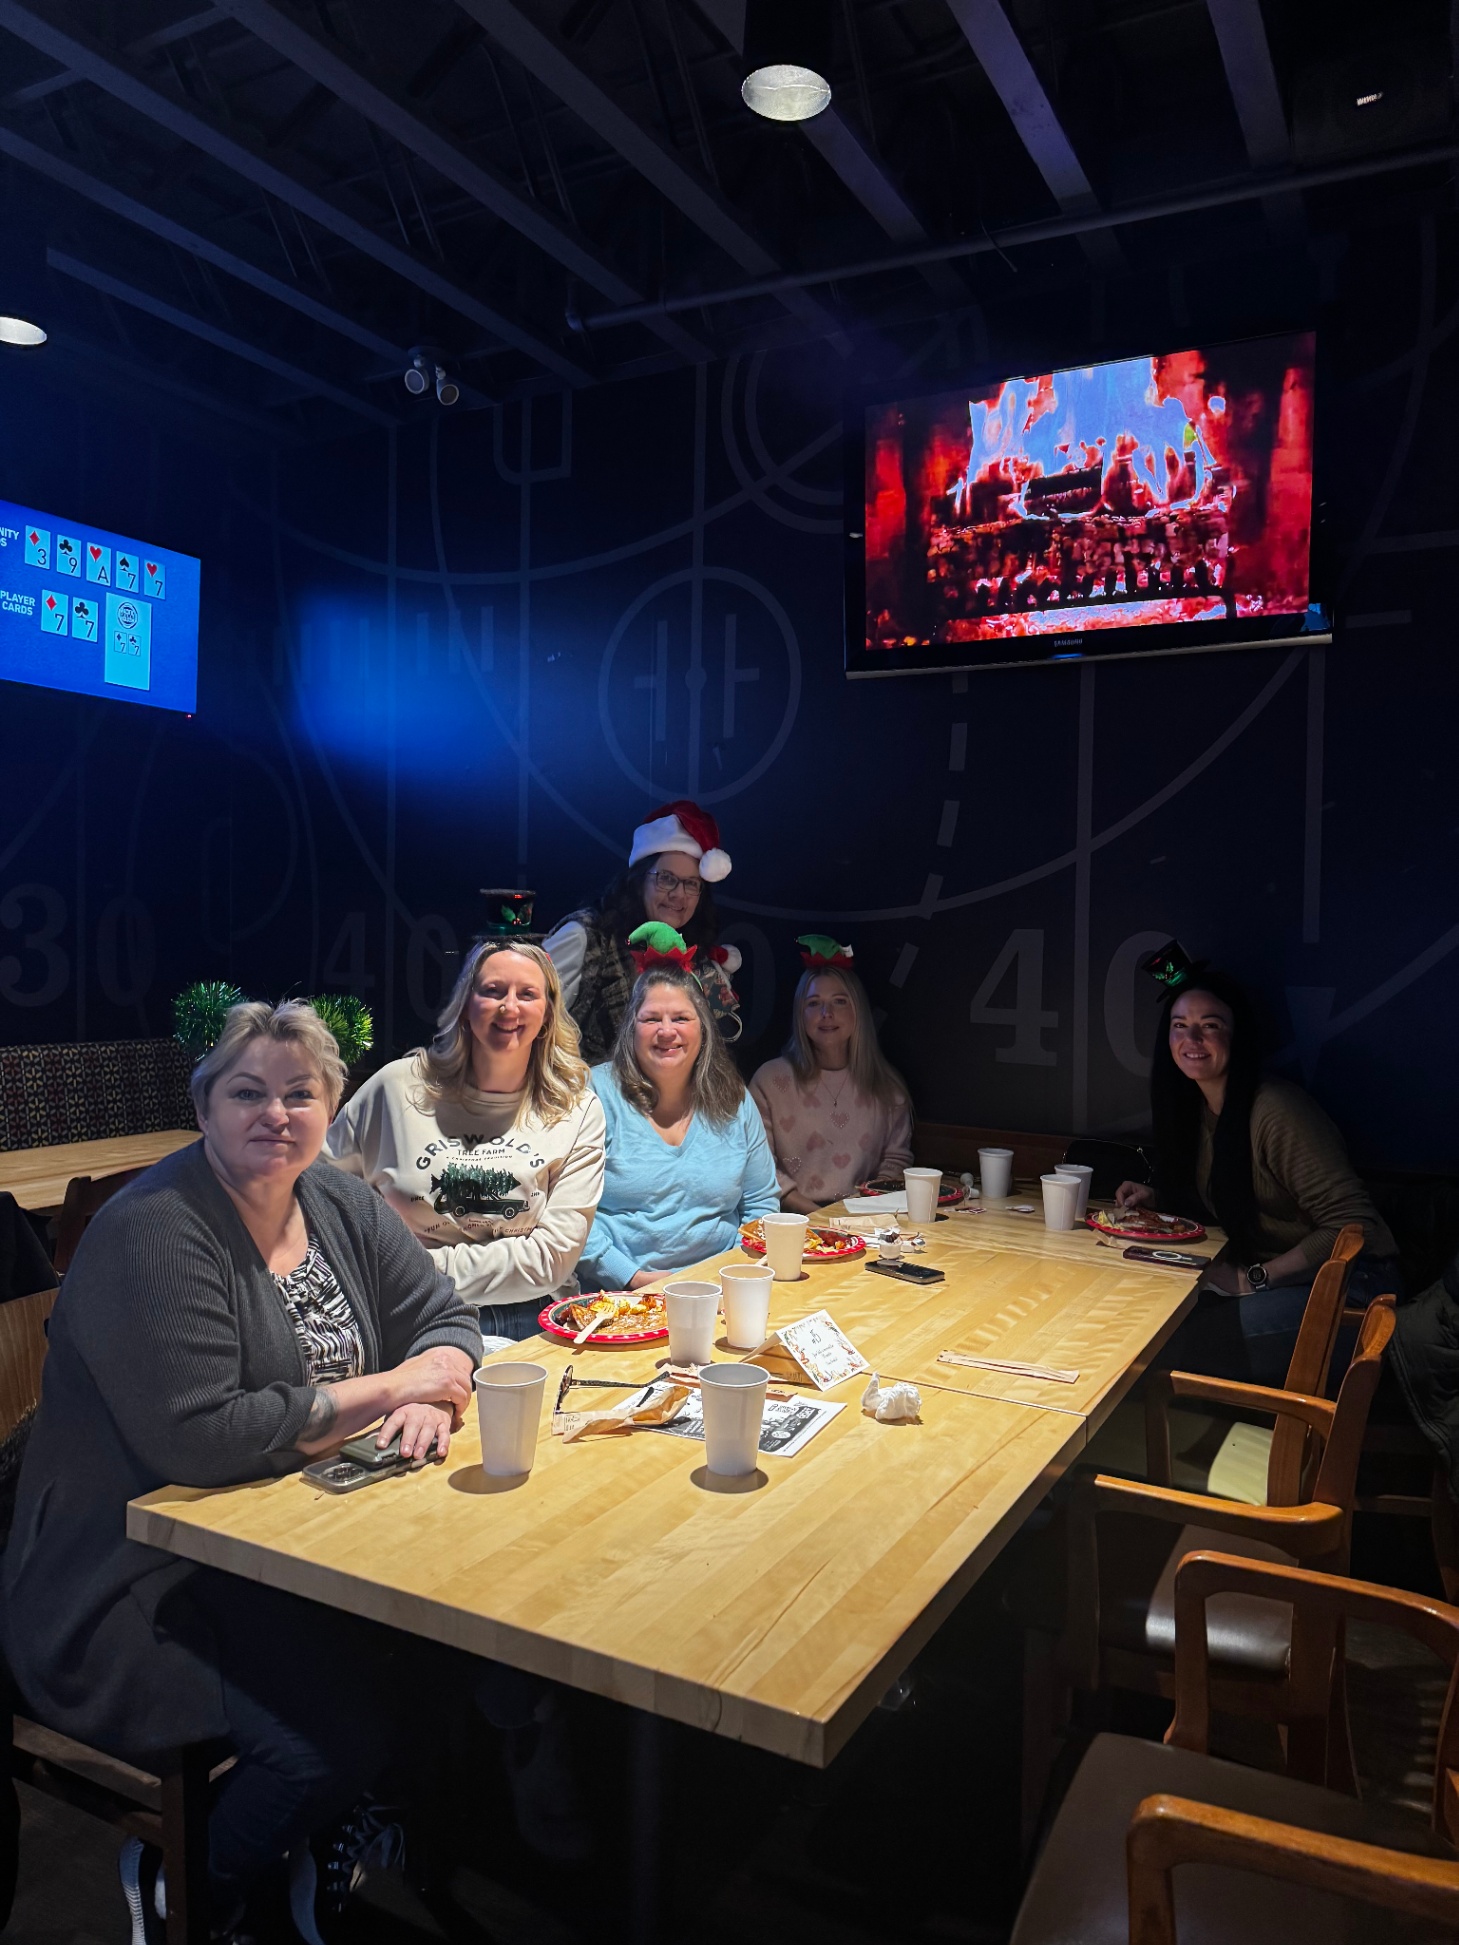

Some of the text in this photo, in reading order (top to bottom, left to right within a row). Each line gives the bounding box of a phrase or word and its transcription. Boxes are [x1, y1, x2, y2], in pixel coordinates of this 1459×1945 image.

[38, 549, 163, 596] 3 9 A 7 7
[0, 590, 35, 606] PLAYER
[2, 602, 33, 616] CARDS
[54, 613, 95, 638] 7 7
[415, 1133, 545, 1170] GRISWOLD'S
[458, 1148, 480, 1156] TREE
